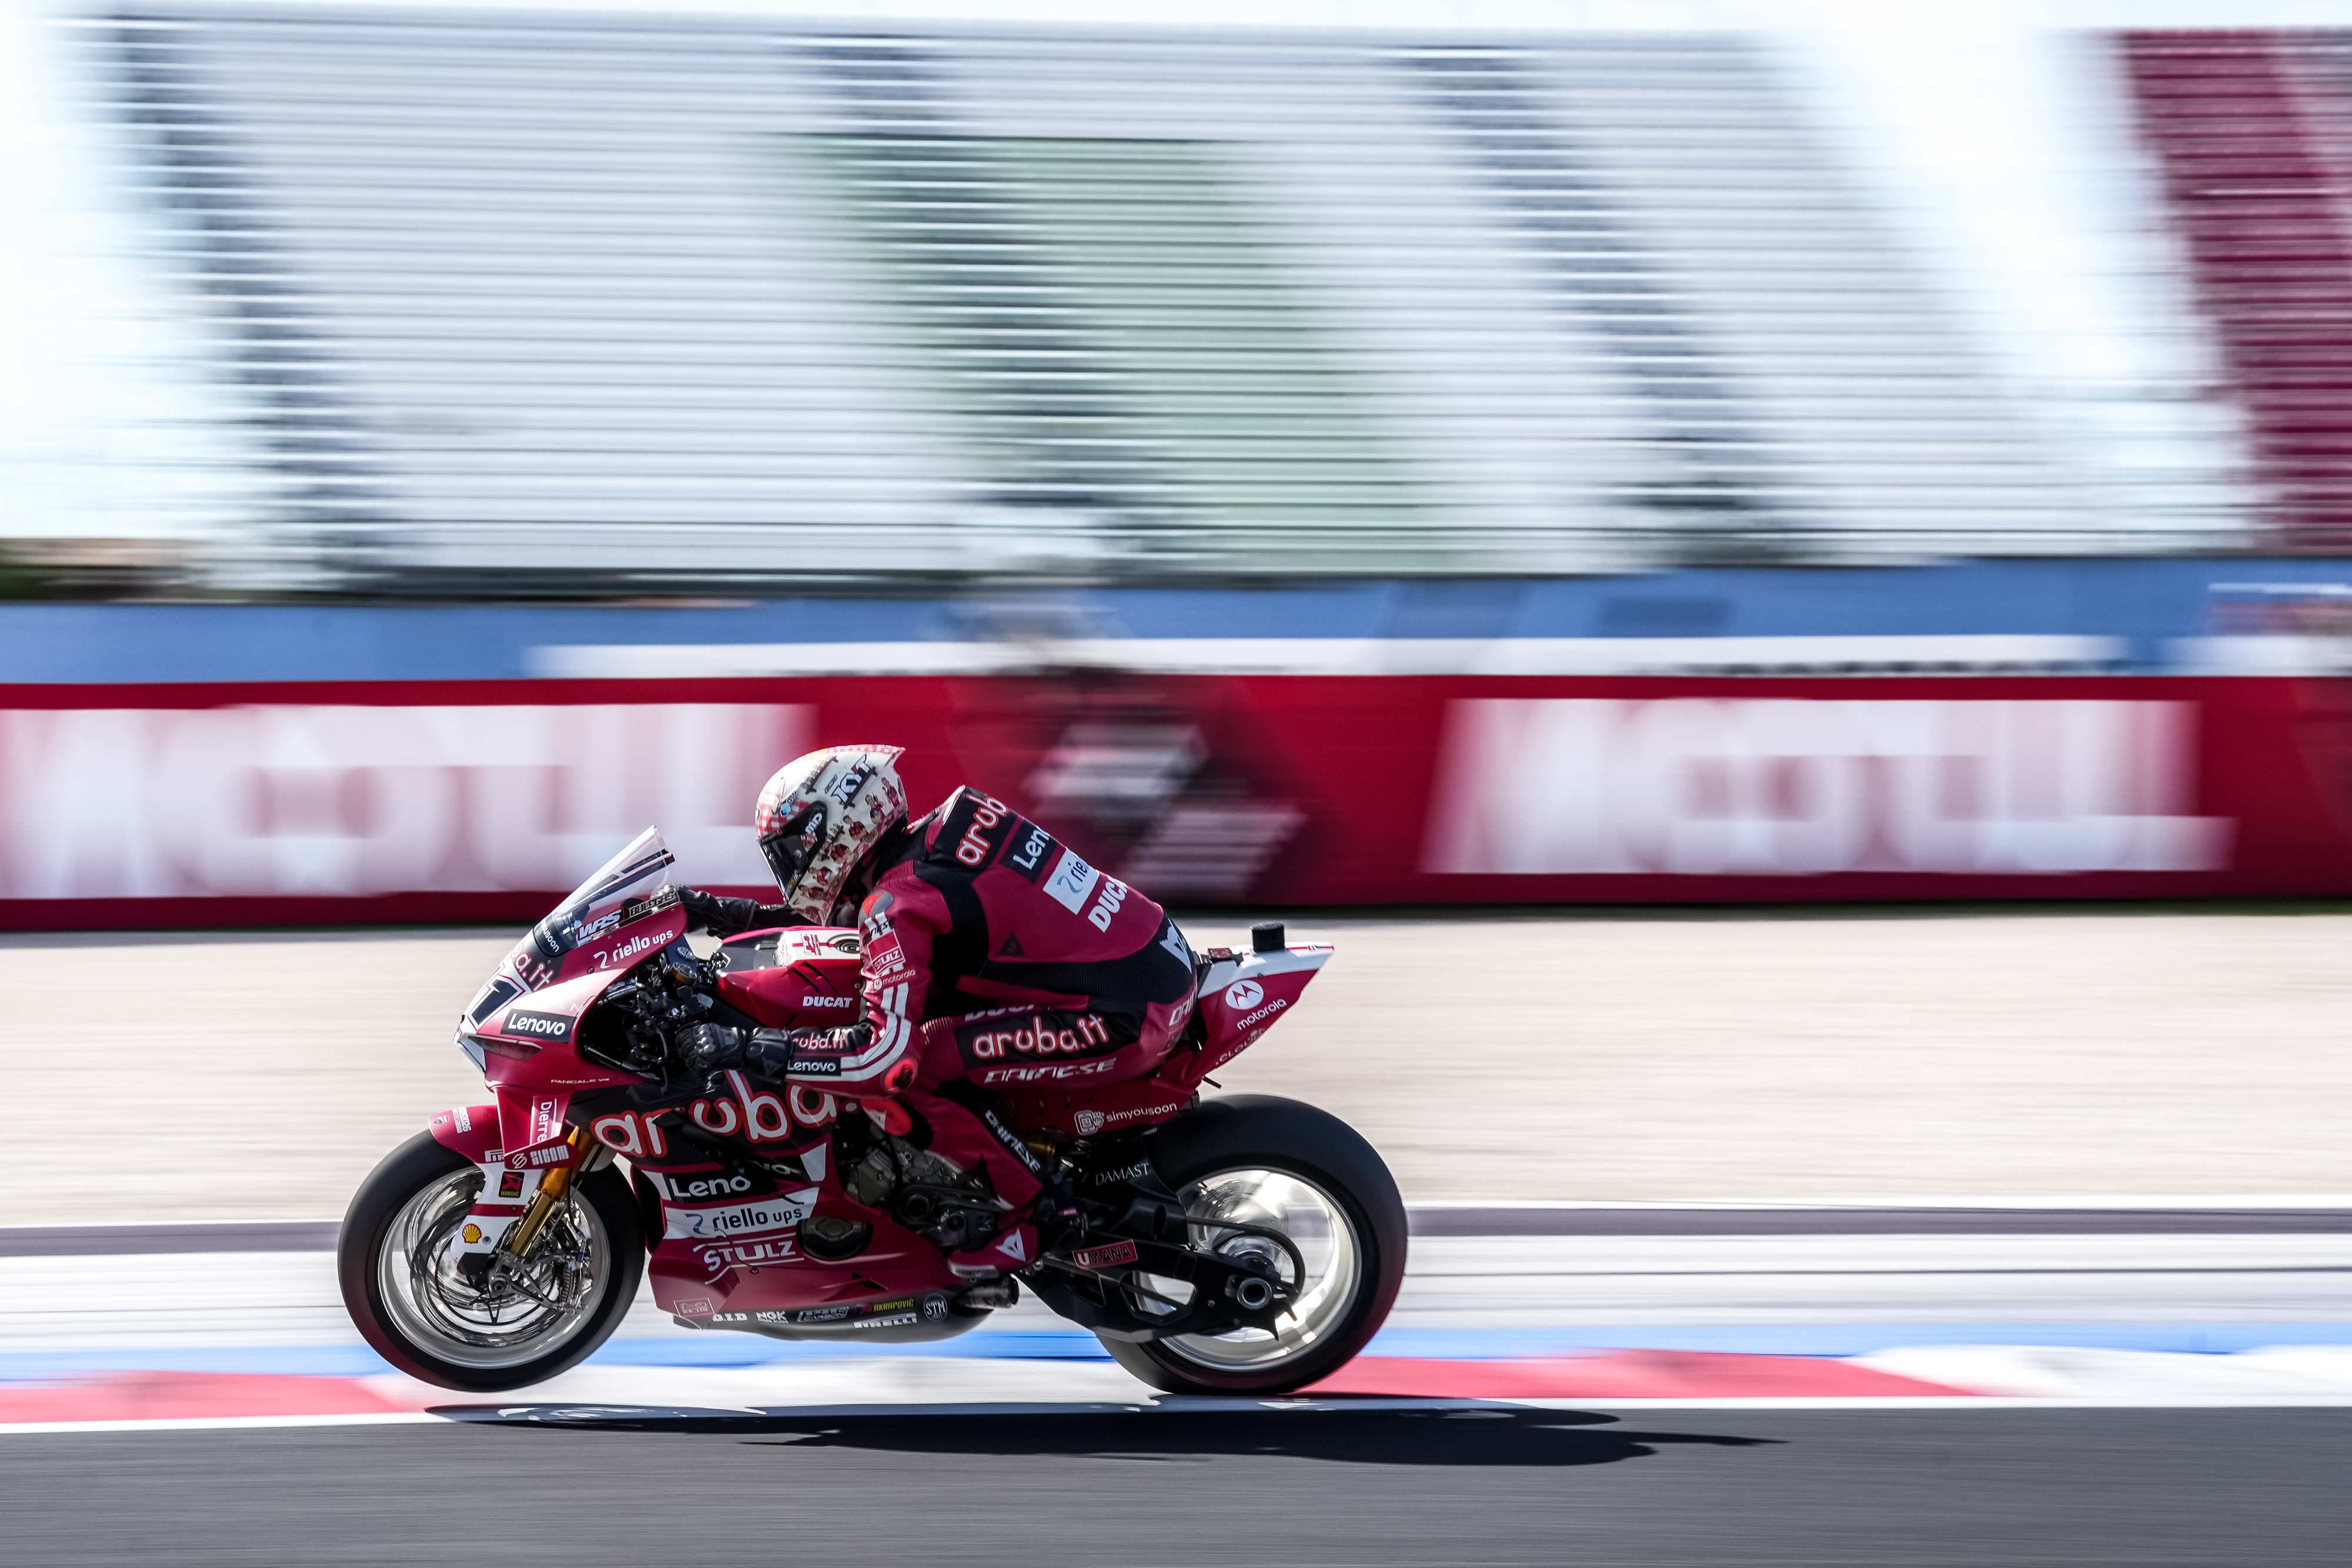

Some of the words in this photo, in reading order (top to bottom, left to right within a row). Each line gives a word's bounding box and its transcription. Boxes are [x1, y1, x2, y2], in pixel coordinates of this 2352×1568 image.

[629, 890, 677, 917] BULEGAS
[578, 909, 622, 939] WRS
[612, 935, 651, 963] riello
[653, 929, 674, 945] ups
[874, 950, 901, 971] STULZ
[882, 968, 916, 986] motorola
[507, 1012, 566, 1036] Lenovo
[1237, 998, 1288, 1031] motorola
[973, 1015, 1110, 1058] aruba.it
[787, 1058, 837, 1072] Lenovo
[984, 1057, 1117, 1084] DAINESE
[1107, 1102, 1177, 1122] simyousoon
[1095, 1162, 1150, 1186] DAMAST
[712, 1207, 769, 1232] riello
[773, 1208, 803, 1225] ups
[704, 1240, 796, 1272] STULZ
[1077, 1244, 1132, 1266] UMANA
[712, 1312, 748, 1322] D.I.D
[926, 1300, 946, 1316] STM
[853, 1312, 917, 1329] PIRELLI
